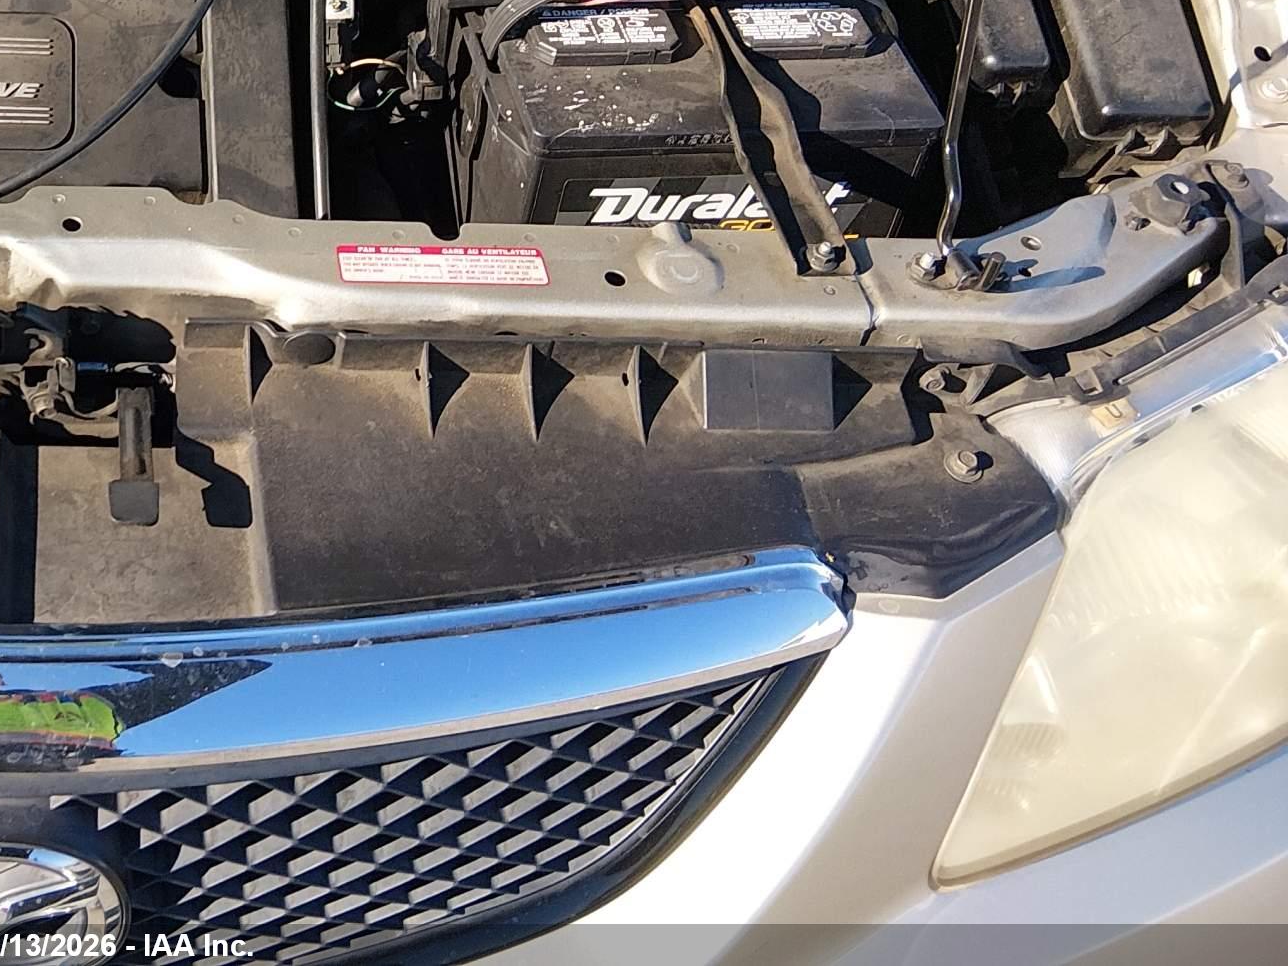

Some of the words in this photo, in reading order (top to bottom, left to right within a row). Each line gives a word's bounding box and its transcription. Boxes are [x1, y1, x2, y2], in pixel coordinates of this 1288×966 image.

[551, 8, 597, 17] DANGER
[357, 246, 376, 254] FAN
[379, 246, 422, 255] WARNING
[480, 248, 538, 257] VENTILATEUR
